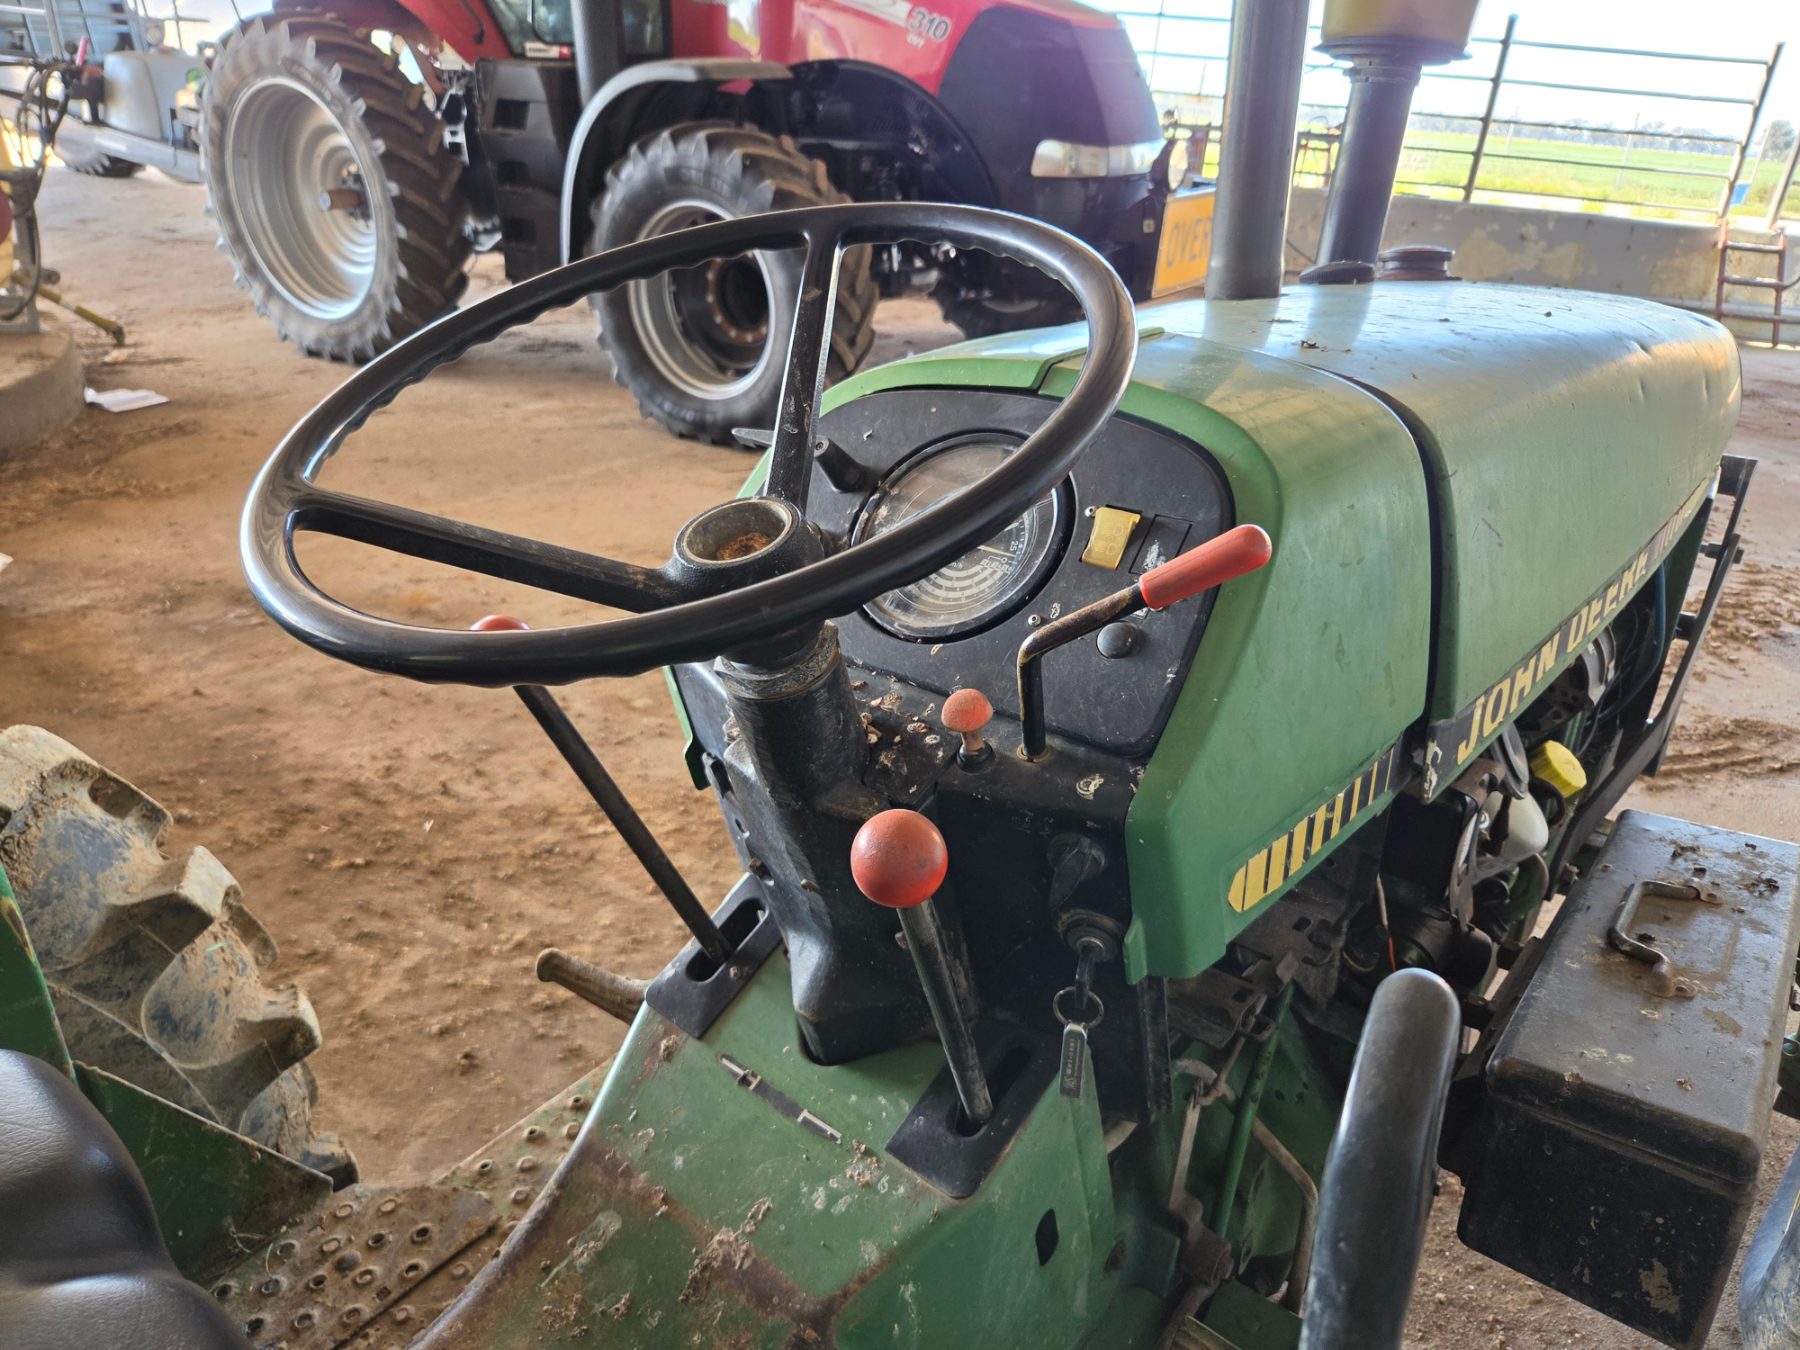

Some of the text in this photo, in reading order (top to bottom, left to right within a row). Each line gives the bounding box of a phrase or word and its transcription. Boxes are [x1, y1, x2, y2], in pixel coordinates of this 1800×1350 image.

[906, 6, 951, 41] 310
[1009, 540, 1019, 552] 25
[1457, 551, 1648, 765] JOHN DEERE
